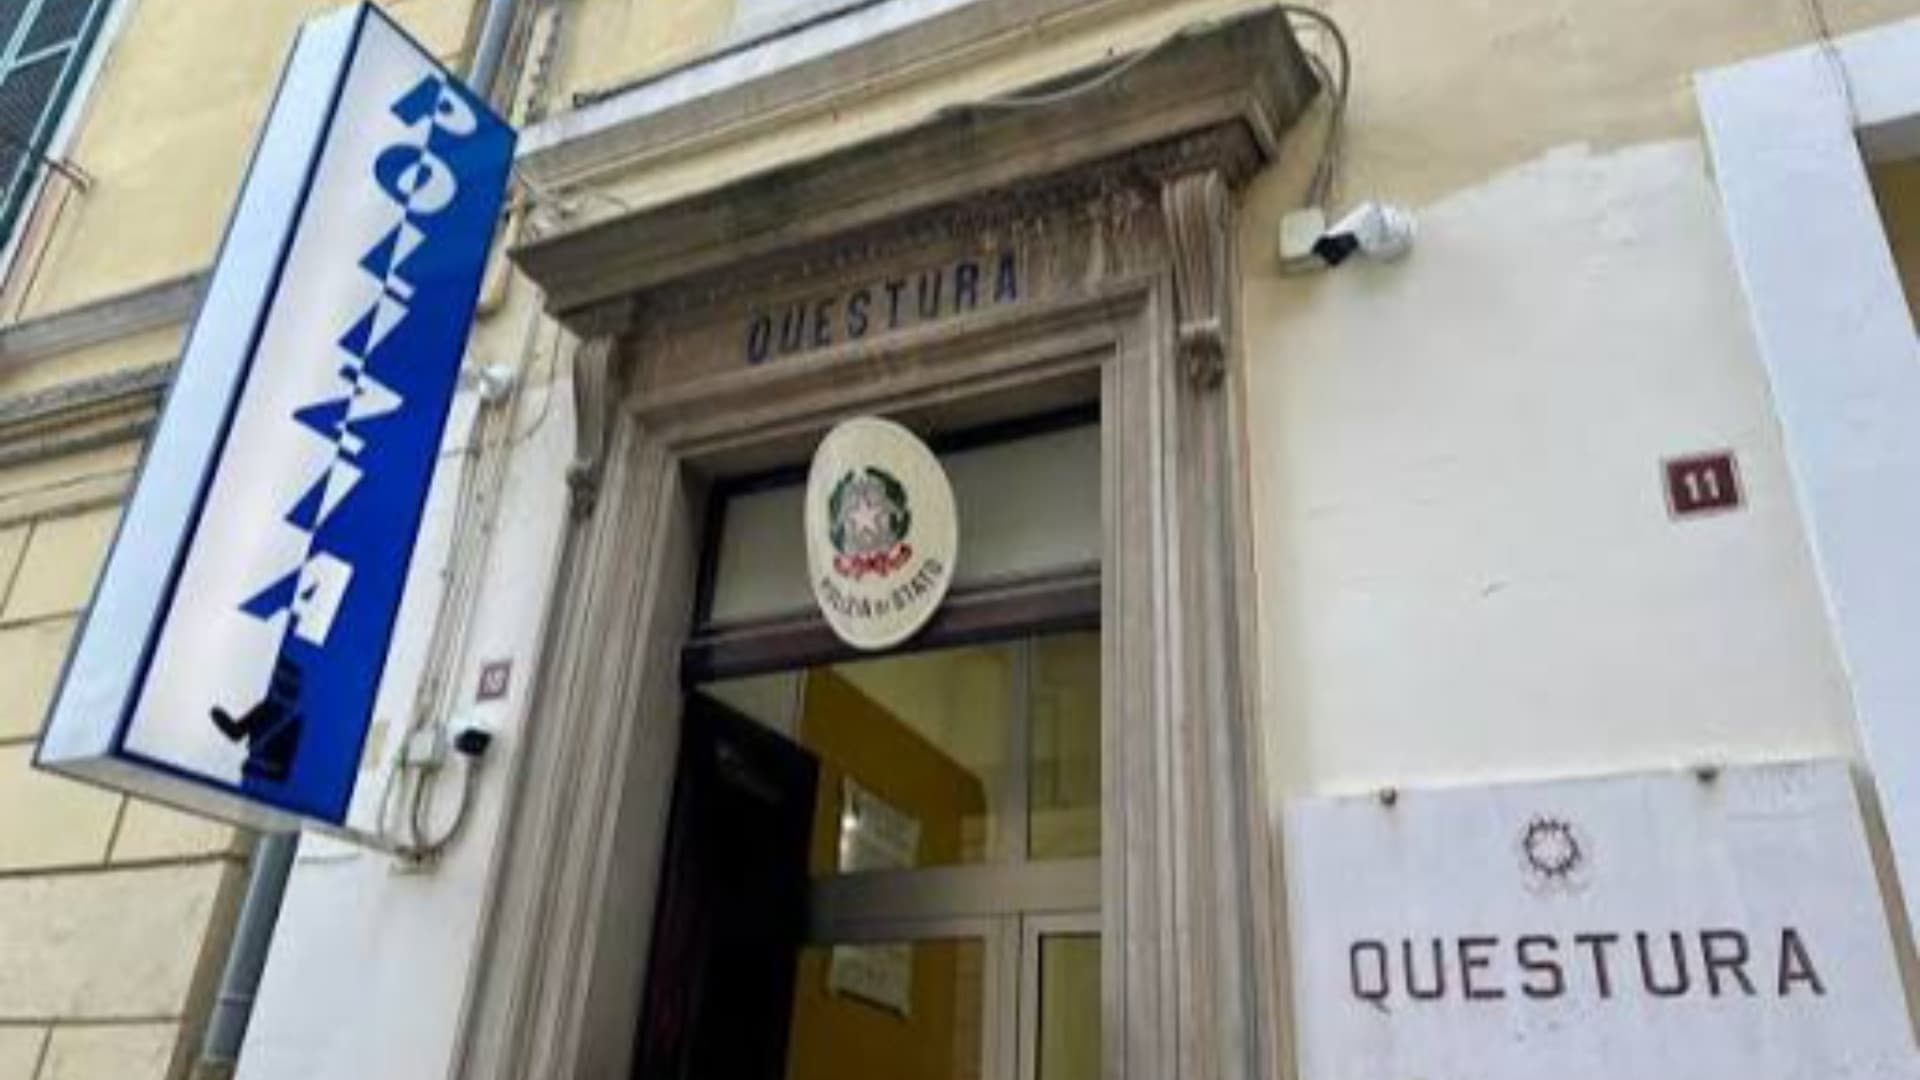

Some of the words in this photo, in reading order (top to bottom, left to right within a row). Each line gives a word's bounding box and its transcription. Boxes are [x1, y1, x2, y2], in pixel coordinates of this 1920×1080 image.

[747, 248, 1017, 365] QUESTURA
[237, 74, 479, 648] POLIZIA
[1684, 468, 1720, 501] 11
[893, 558, 943, 611] STATO
[1349, 927, 1826, 1014] QUESTURA
